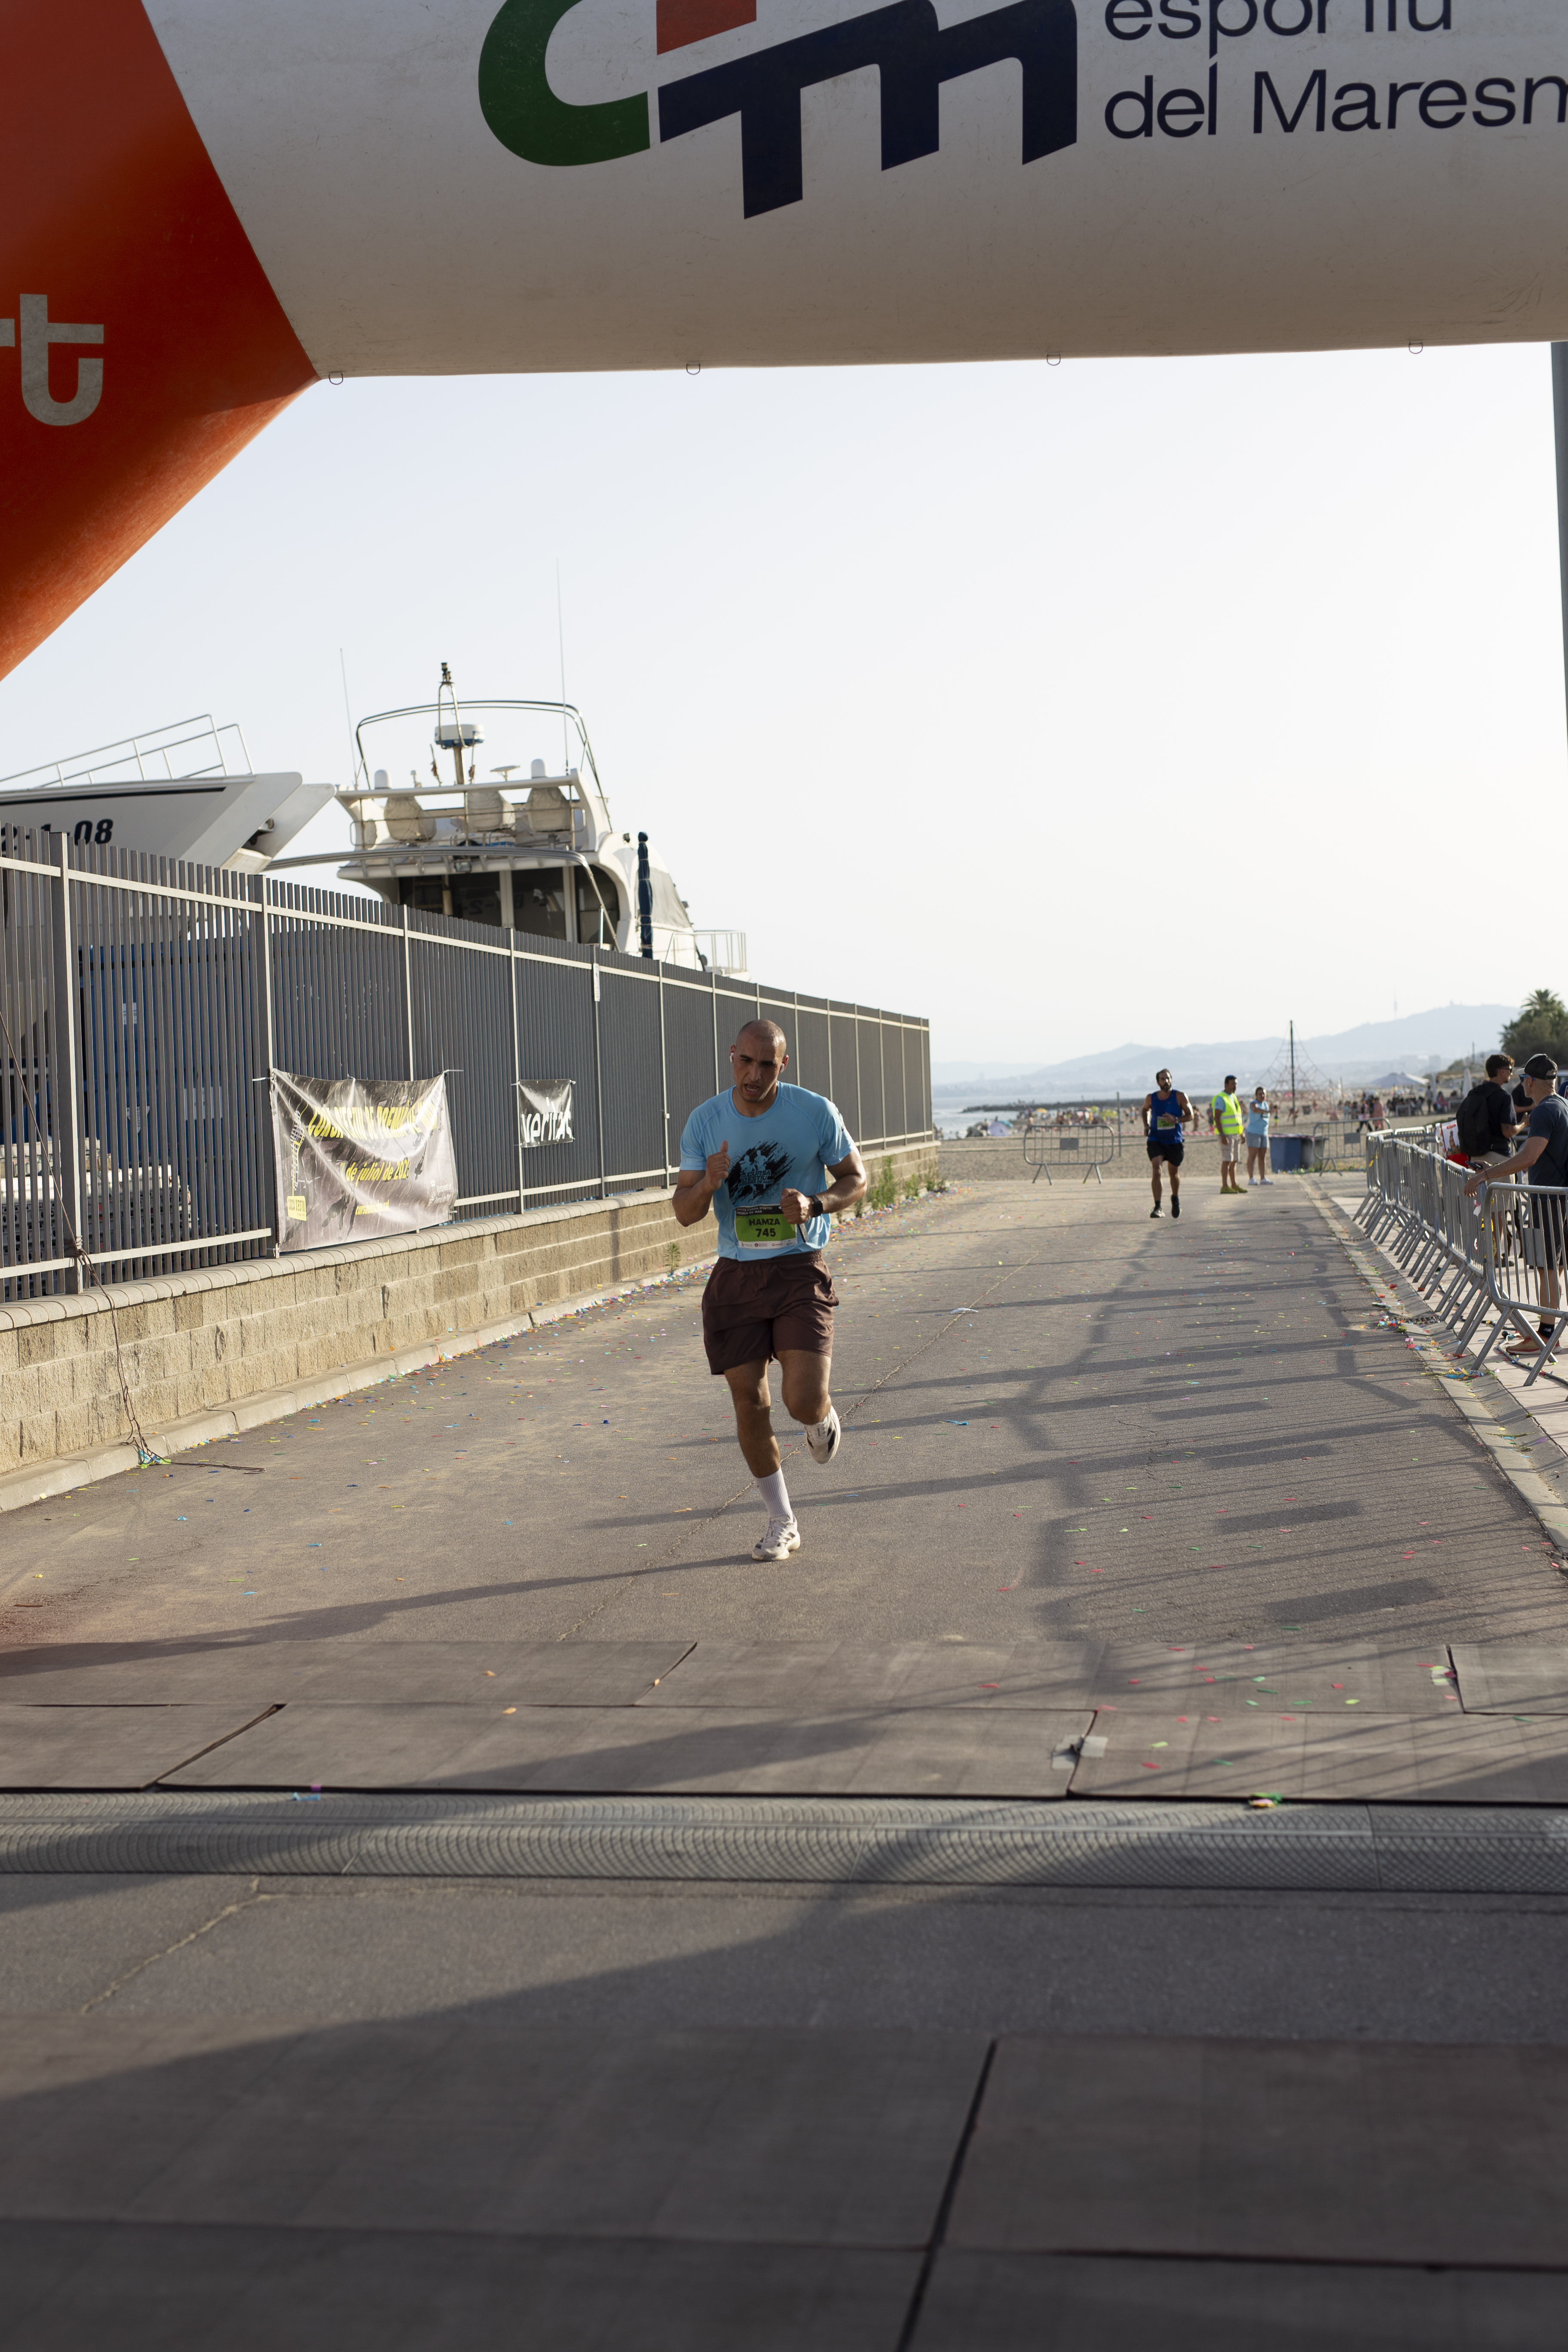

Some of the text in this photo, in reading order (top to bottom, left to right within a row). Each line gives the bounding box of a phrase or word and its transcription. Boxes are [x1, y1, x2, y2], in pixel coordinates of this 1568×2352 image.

[1105, 61, 1216, 139] del
[346, 1162, 358, 1182] de
[355, 1162, 385, 1187] juliol
[382, 1161, 394, 1181] de
[756, 1228, 776, 1237] 745
